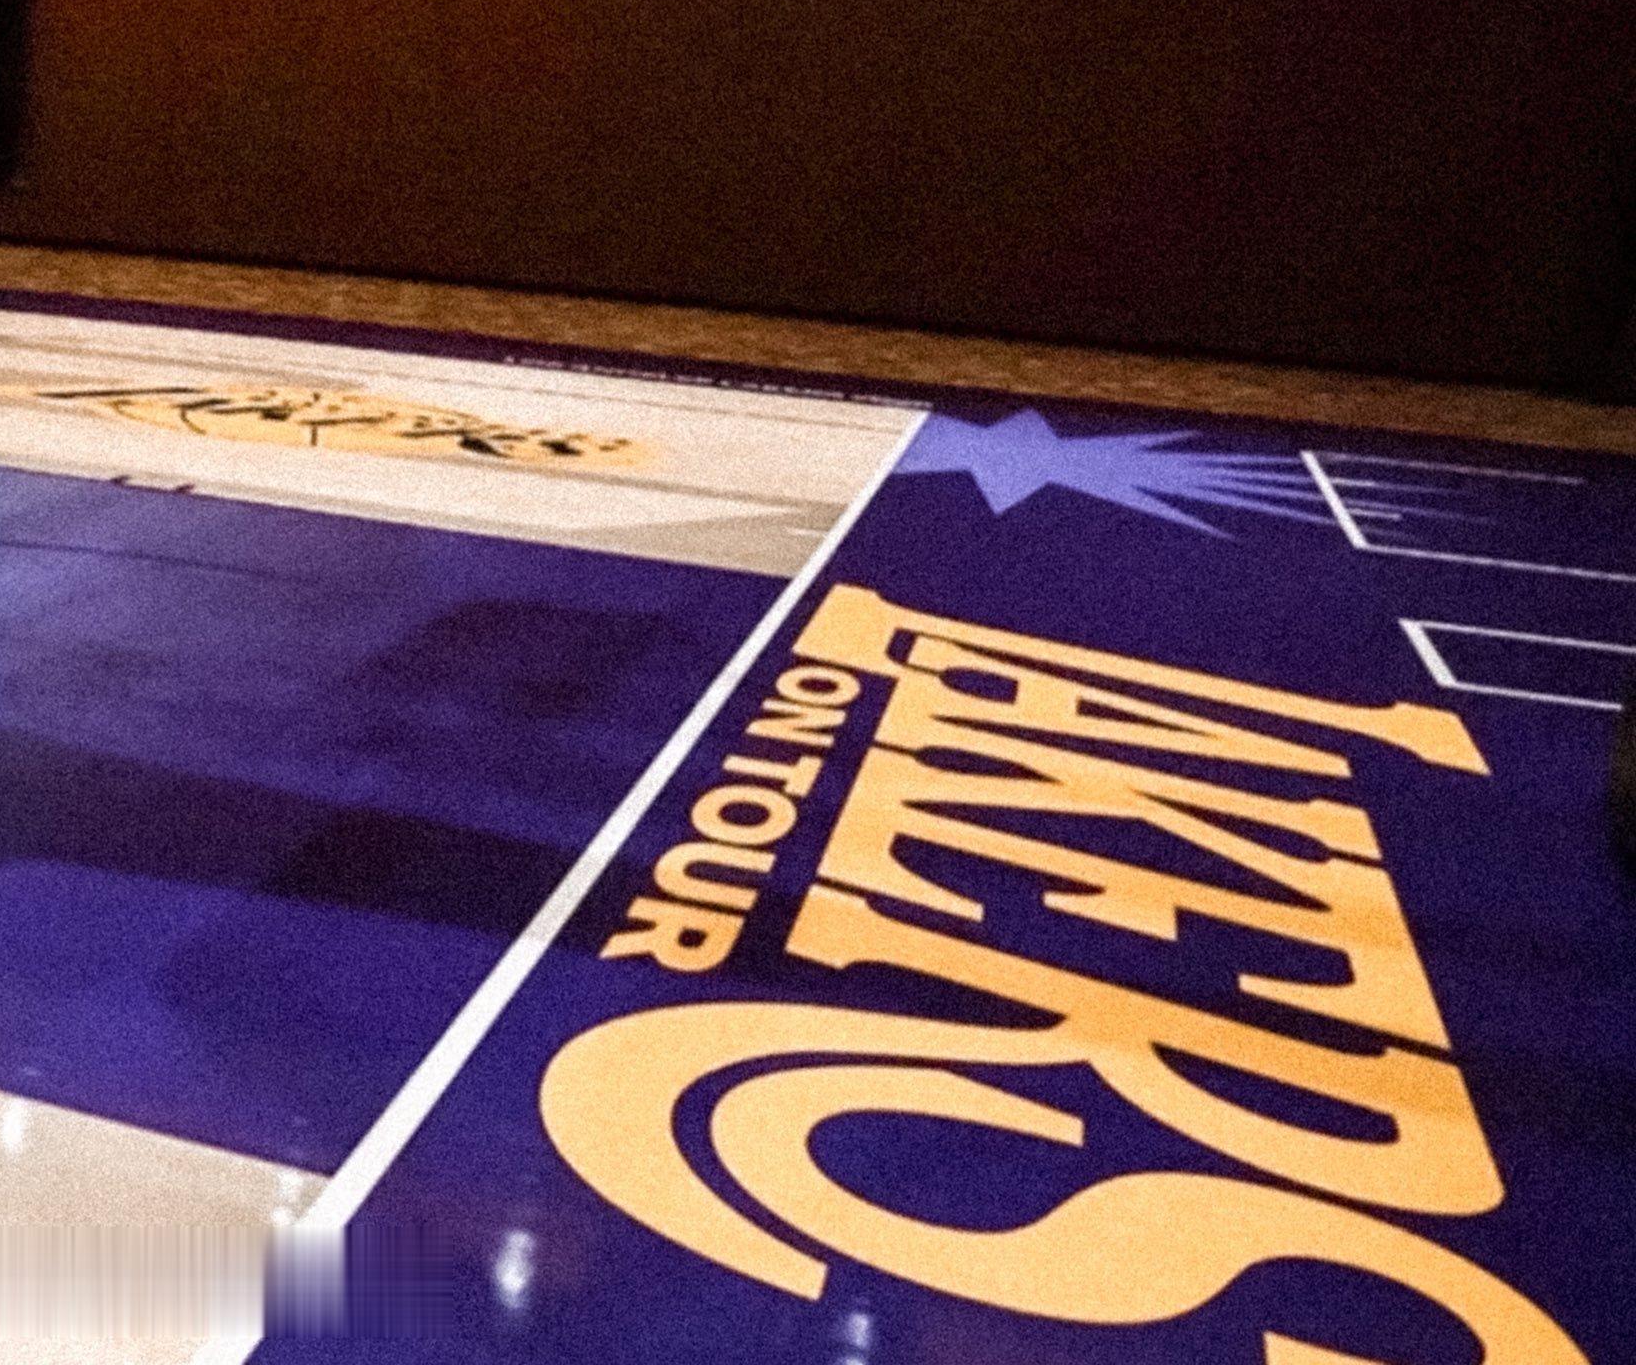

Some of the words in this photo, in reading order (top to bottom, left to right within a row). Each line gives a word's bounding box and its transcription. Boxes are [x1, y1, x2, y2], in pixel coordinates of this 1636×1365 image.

[745, 665, 862, 748] ON
[599, 754, 824, 972] TOUR
[539, 584, 1592, 1365] LAKERS
